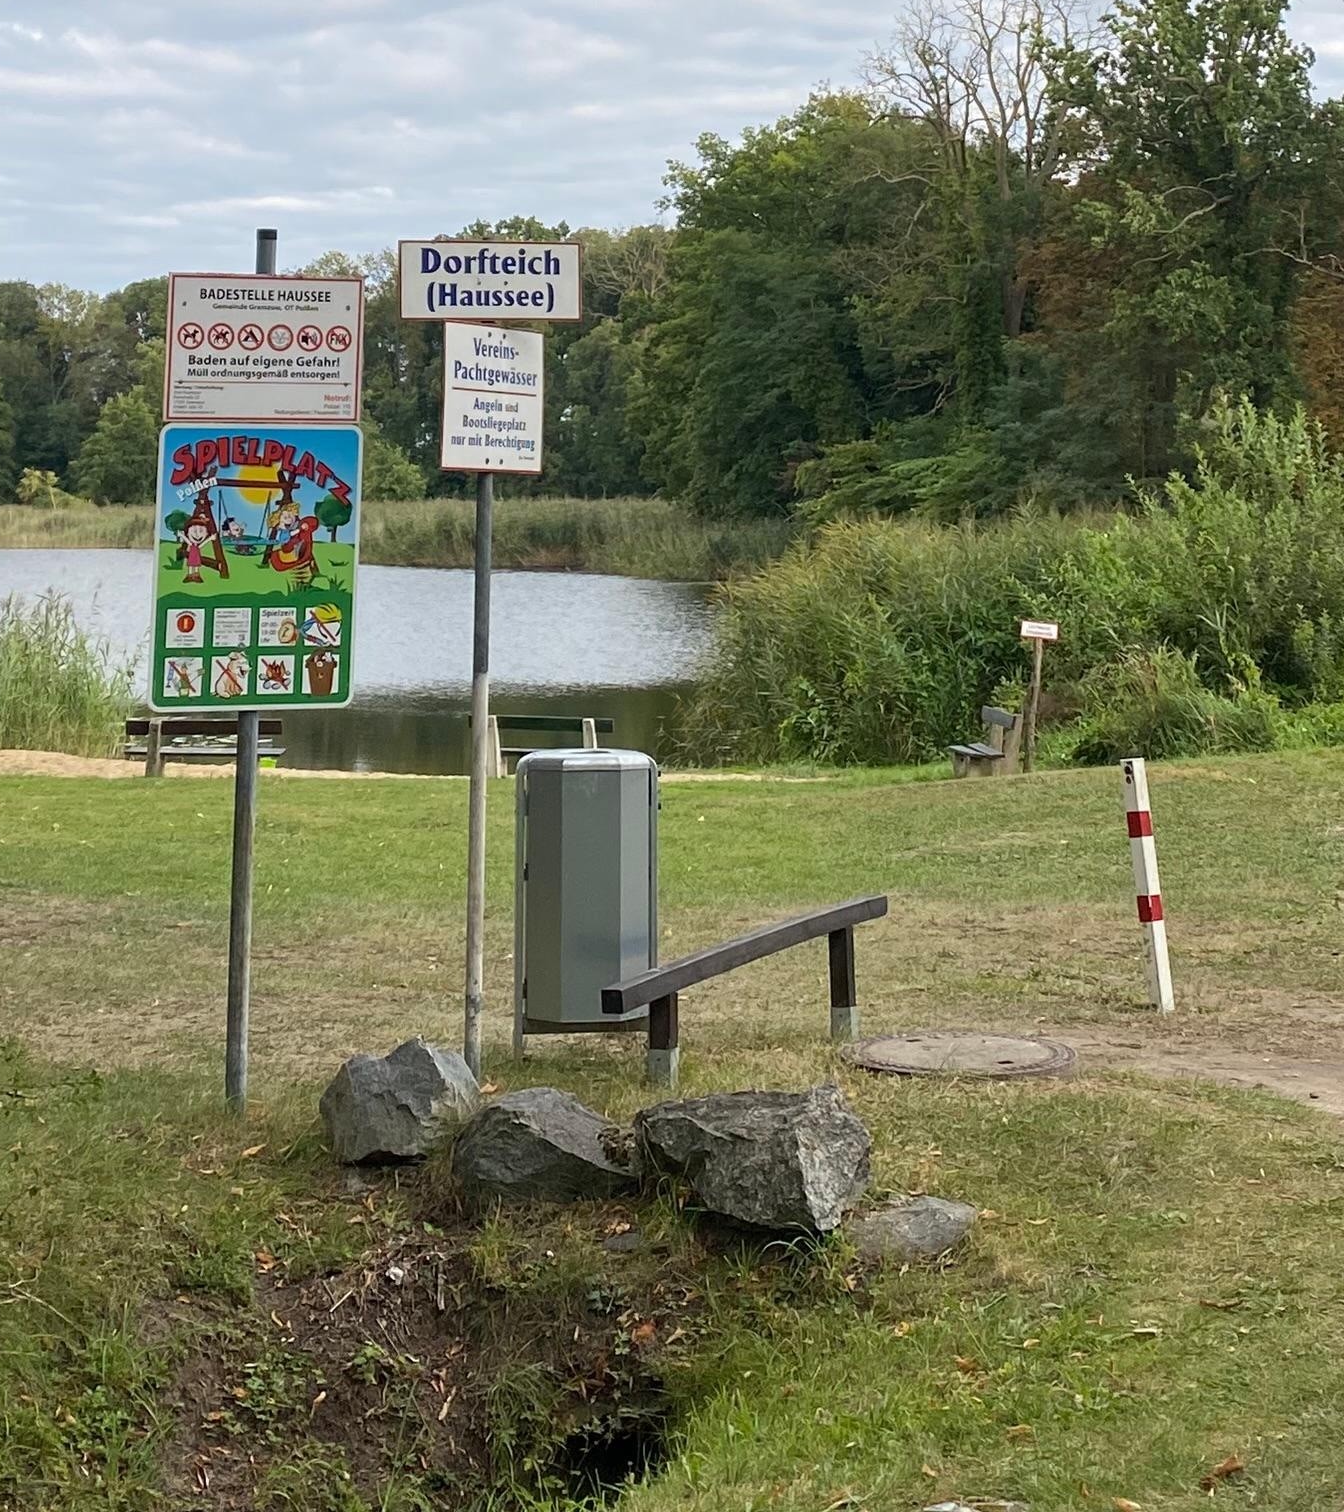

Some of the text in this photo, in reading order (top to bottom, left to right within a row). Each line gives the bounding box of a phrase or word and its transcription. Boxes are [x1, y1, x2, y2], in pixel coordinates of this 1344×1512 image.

[420, 247, 560, 275] Dorfteich
[200, 288, 331, 302] BADESTELLE HAUSSEE
[427, 281, 554, 313] (Haussee)
[473, 337, 519, 360] Vereins-
[188, 355, 340, 369] Baden auf eigene Gefahr!
[187, 368, 340, 380] Müll ordnungsgemäß entsorgen!
[454, 359, 537, 387] Pachtgewässer
[473, 397, 519, 414] Angeln und
[462, 414, 527, 432] Bootsliegeplatz
[451, 433, 535, 452] nur mit Berechtigung
[170, 435, 353, 506] SPIELPLATZ
[176, 476, 218, 502] Polßen
[261, 609, 295, 618] Spielzeit
